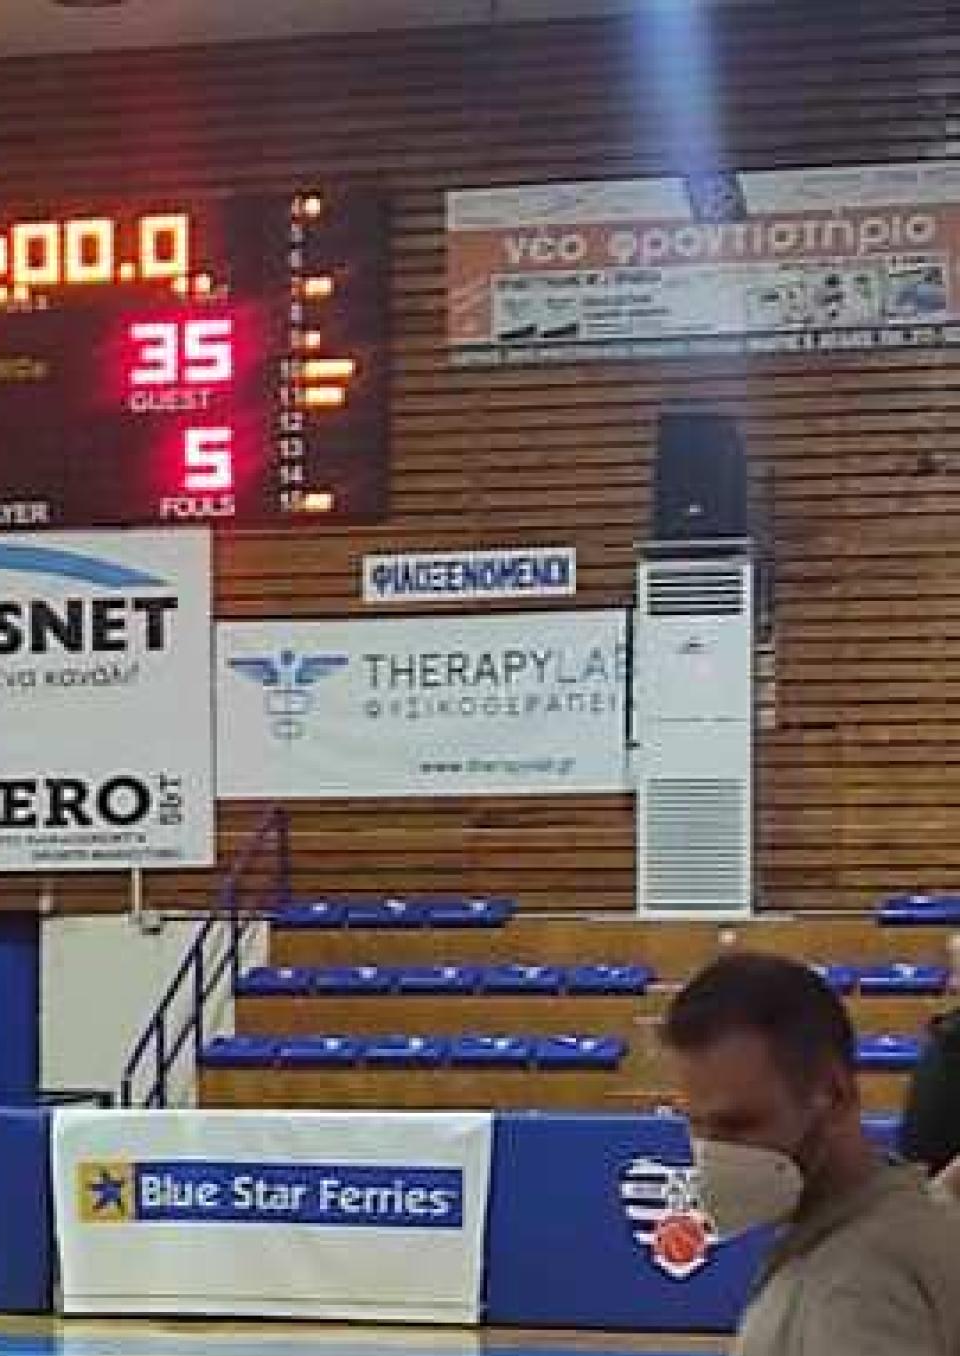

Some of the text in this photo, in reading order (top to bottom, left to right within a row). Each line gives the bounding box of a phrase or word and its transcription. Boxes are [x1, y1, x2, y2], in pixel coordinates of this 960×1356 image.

[130, 319, 234, 385] 35
[184, 427, 234, 488] 5
[159, 494, 236, 518] FOULS
[140, 1175, 457, 1216] Blue Star Ferries
